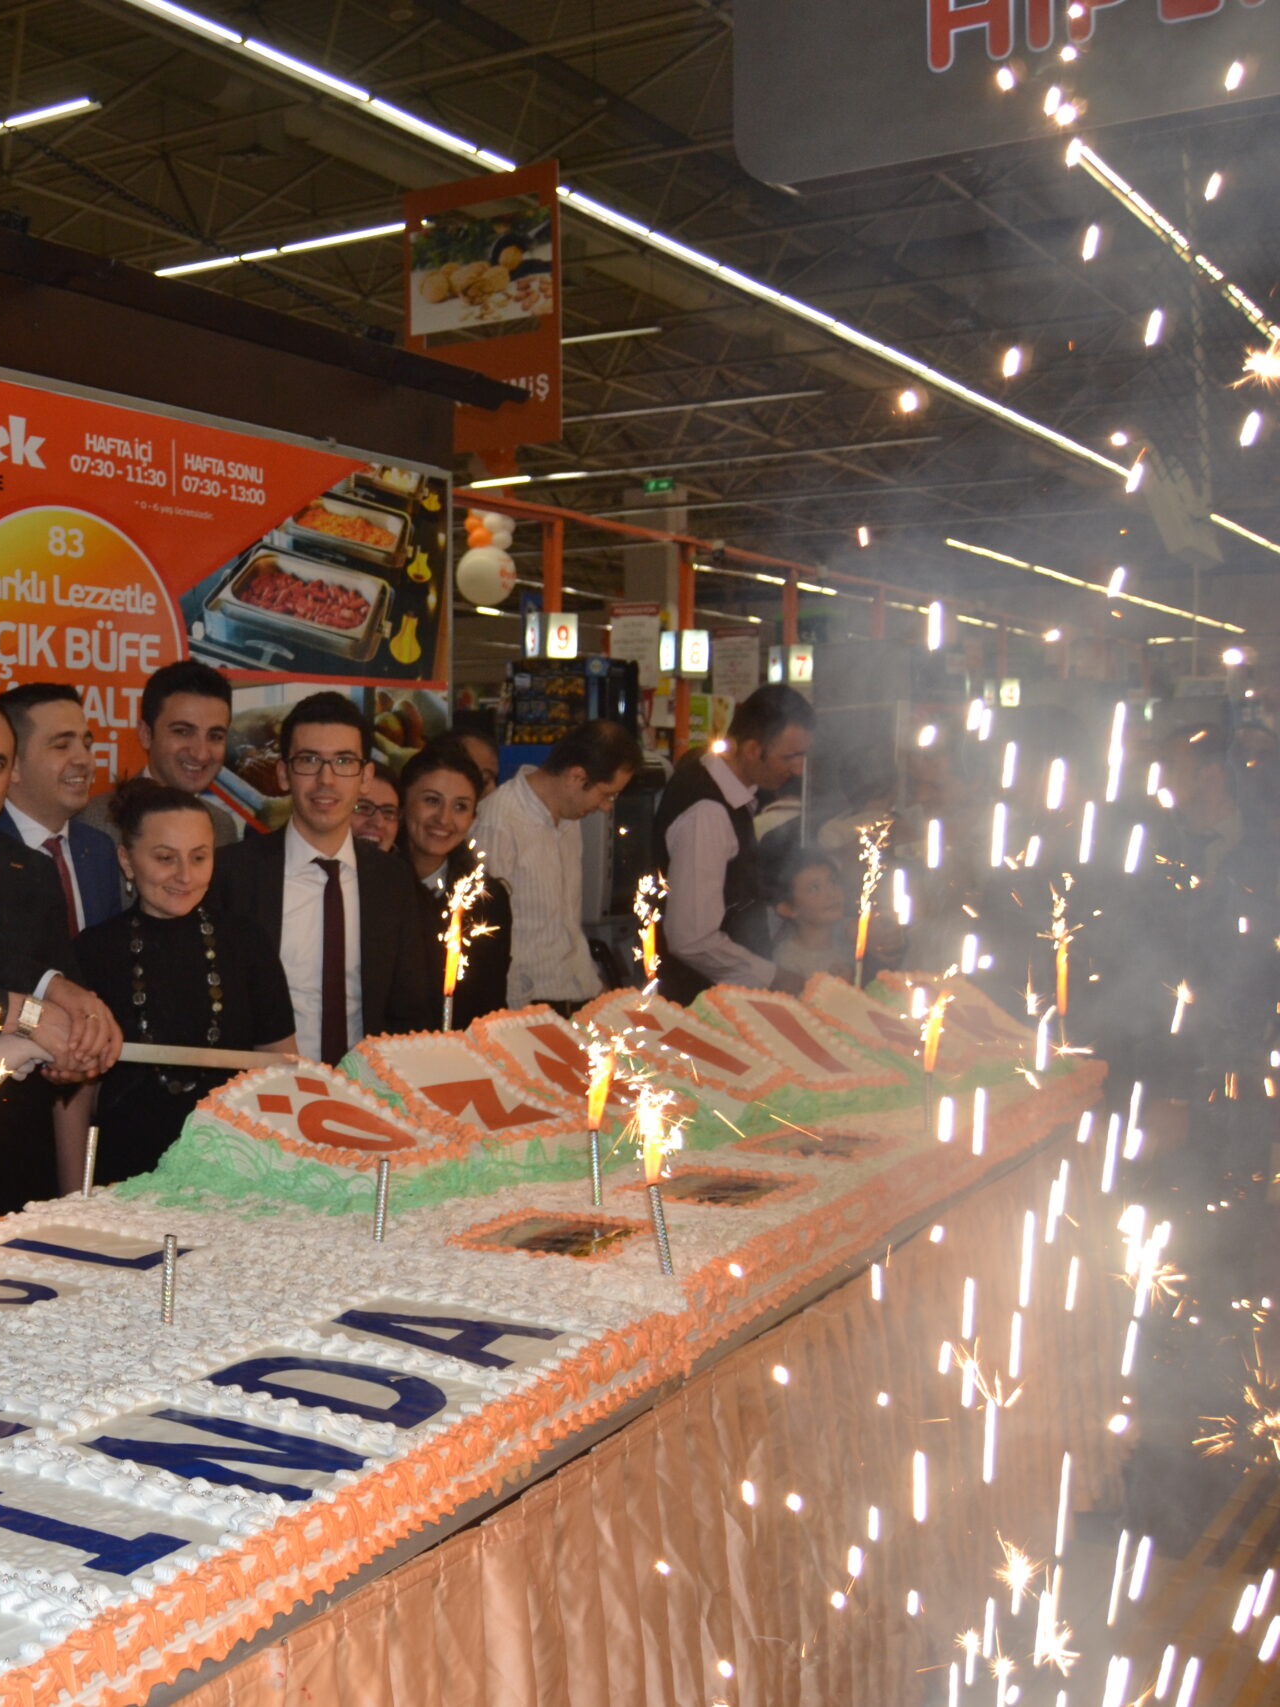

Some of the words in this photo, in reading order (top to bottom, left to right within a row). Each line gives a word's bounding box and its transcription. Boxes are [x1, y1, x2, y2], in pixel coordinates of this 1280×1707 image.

[85, 433, 132, 459] HAFTA
[134, 438, 153, 467] İÇİ
[70, 454, 115, 478] 07:30
[126, 465, 167, 487] 11:30
[184, 452, 226, 477] HAFTA
[227, 462, 264, 484] SONU
[182, 475, 221, 497] 07:30
[230, 484, 266, 505] 13:00
[48, 526, 85, 559] 83
[53, 574, 157, 616] Lezzetle
[65, 620, 161, 674] BÜFE
[556, 625, 569, 650] 9
[795, 655, 808, 677] 7
